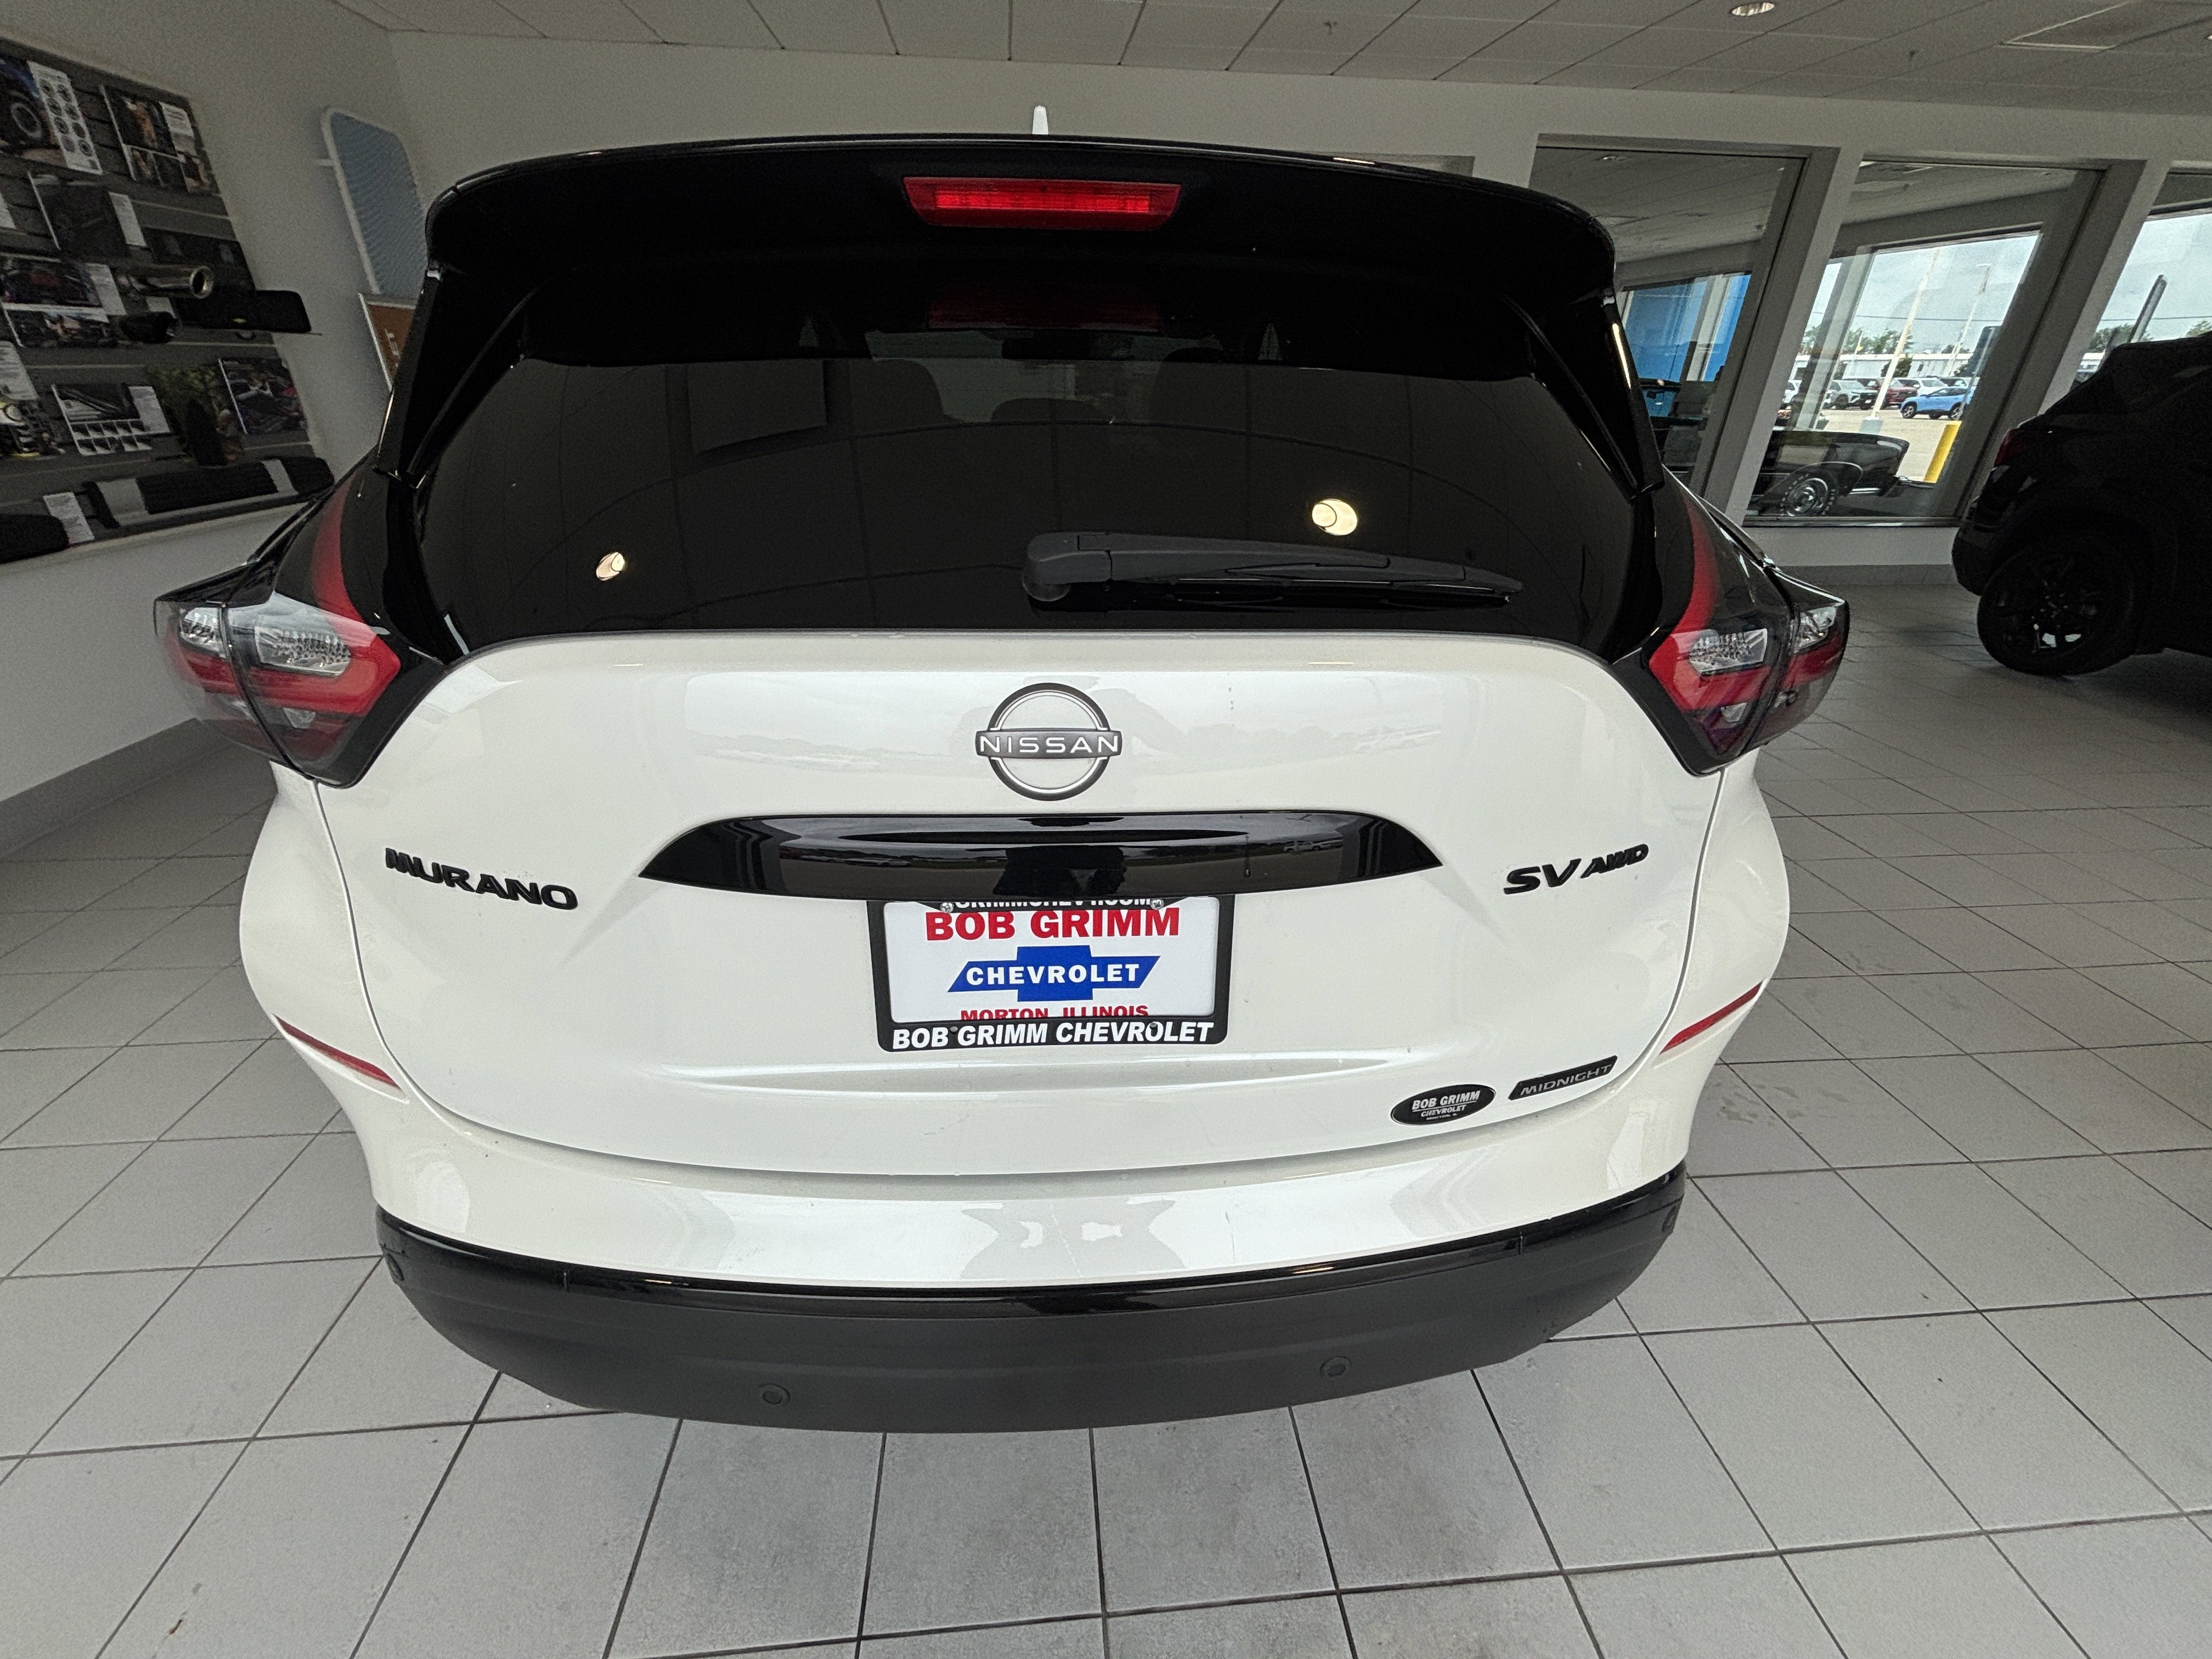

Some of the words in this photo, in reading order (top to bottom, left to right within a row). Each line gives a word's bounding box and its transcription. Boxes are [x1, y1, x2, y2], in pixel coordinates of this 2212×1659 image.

[979, 735, 1119, 754] NISSAN
[385, 847, 578, 910] MURANO
[1503, 857, 1582, 895] SV
[1580, 843, 1649, 879] AWD
[926, 910, 1015, 941] BOB
[1030, 907, 1180, 939] GRIMM
[966, 963, 1140, 986] CHEVROLET
[892, 1026, 949, 1049] BOB
[957, 1023, 1048, 1046] GRIMM
[1056, 1022, 1215, 1043] CHEVROLET
[1520, 1063, 1612, 1097] MIDNIGHT
[1412, 1098, 1437, 1110] BOB
[1440, 1090, 1481, 1106] GRIMM
[1420, 1104, 1467, 1118] CHEVROLET
